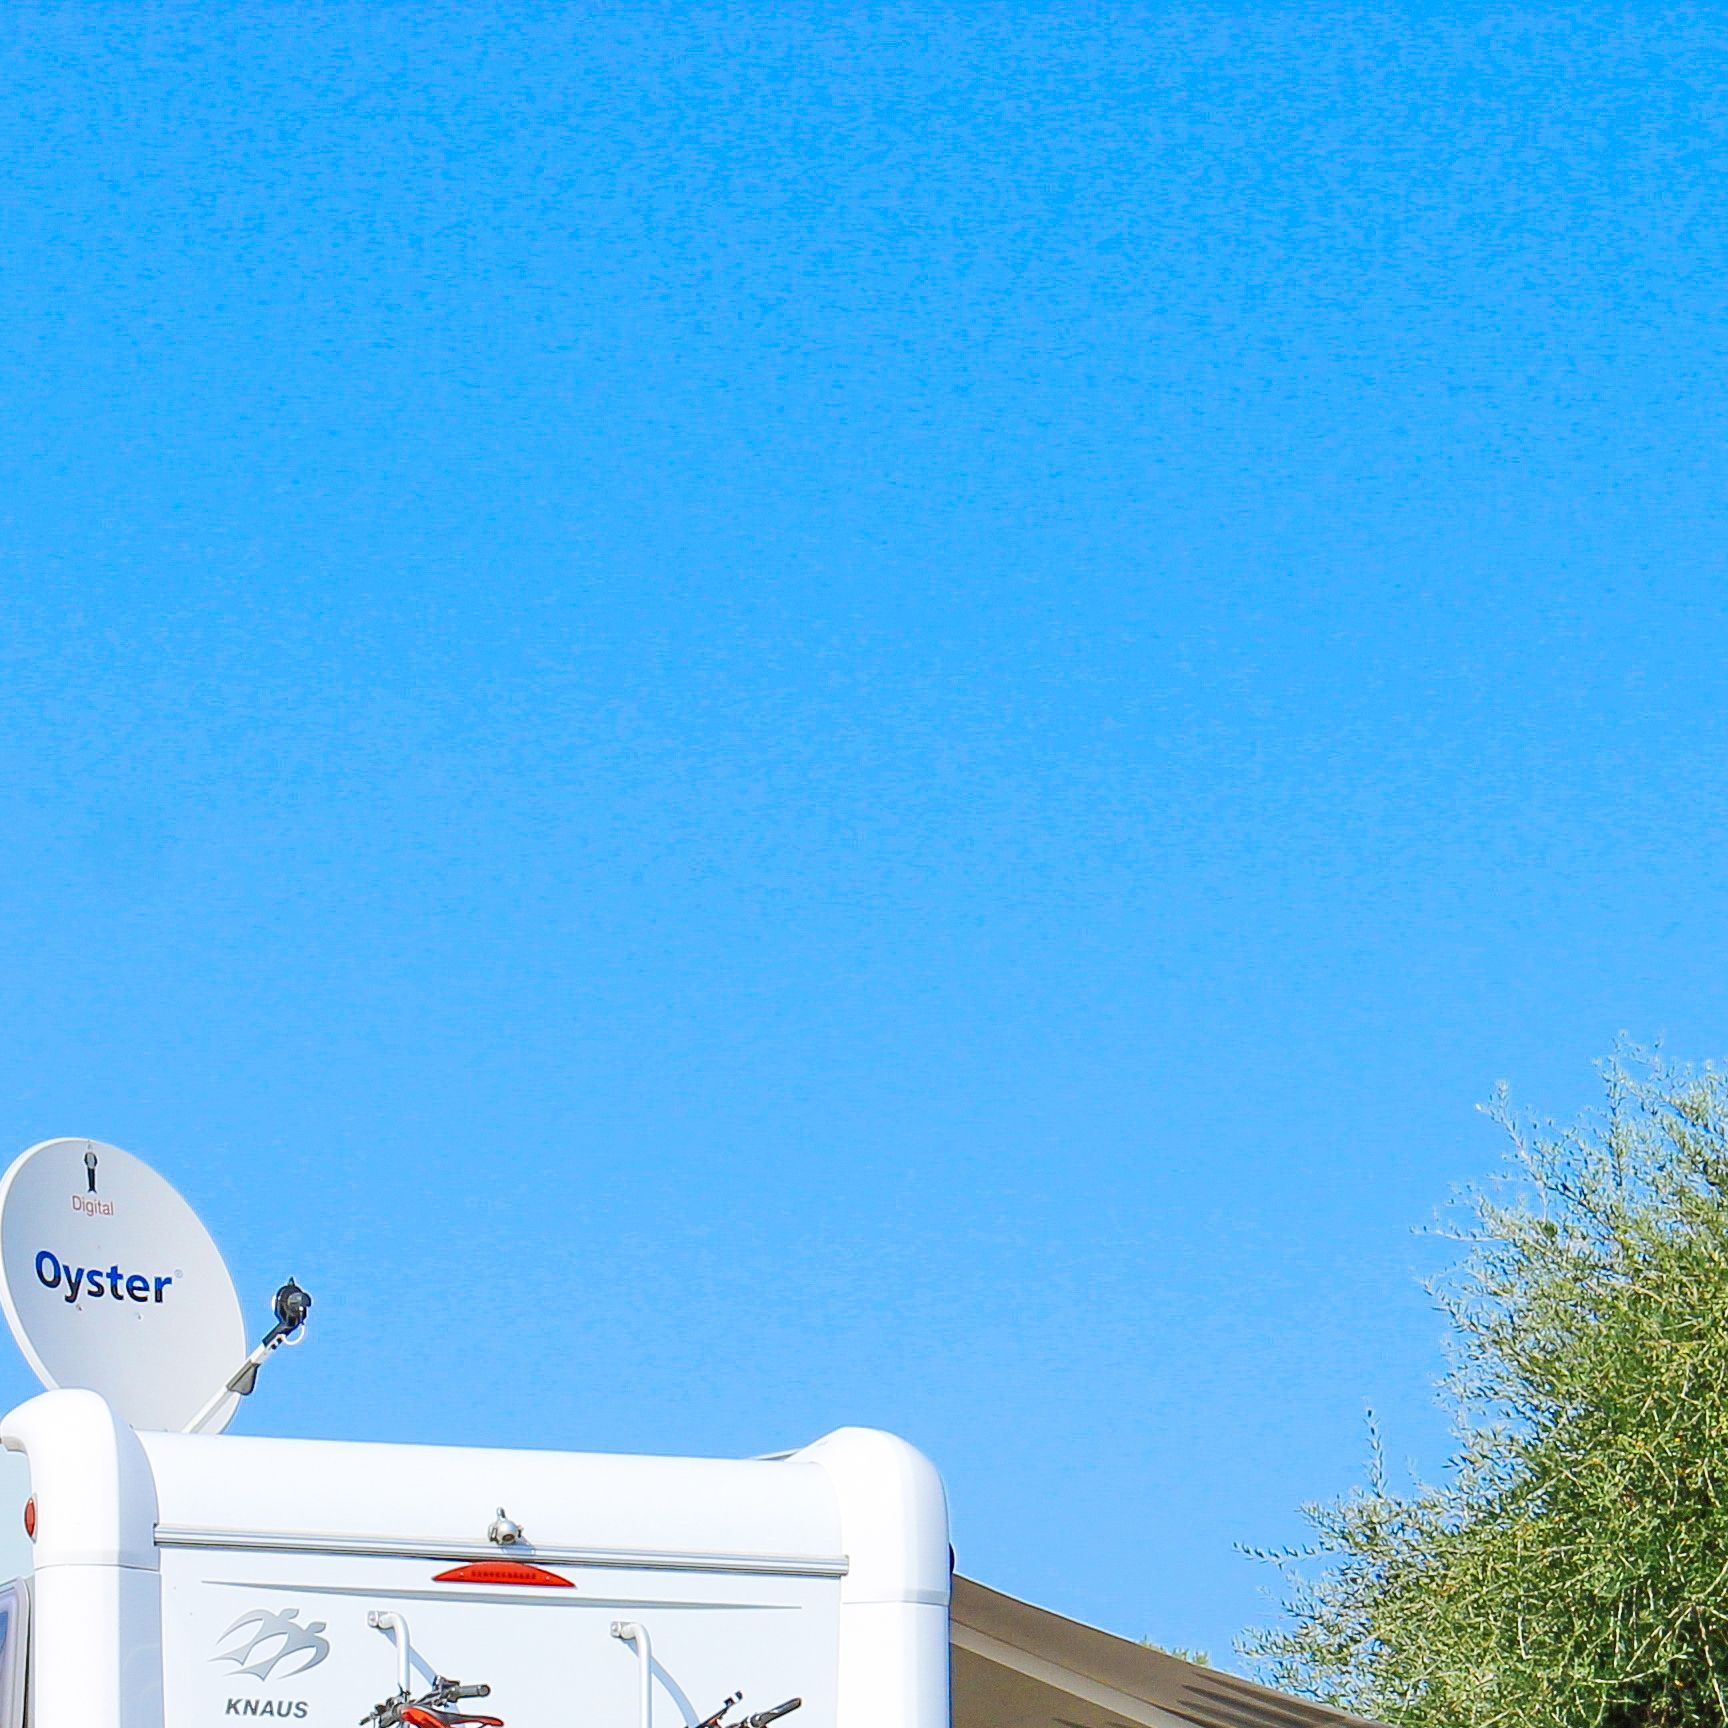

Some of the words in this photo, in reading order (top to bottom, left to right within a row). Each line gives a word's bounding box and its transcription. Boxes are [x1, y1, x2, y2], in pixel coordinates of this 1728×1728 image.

[71, 1195, 115, 1217] Digital
[34, 1249, 173, 1304] Oyster
[224, 1697, 309, 1719] KNAUS
